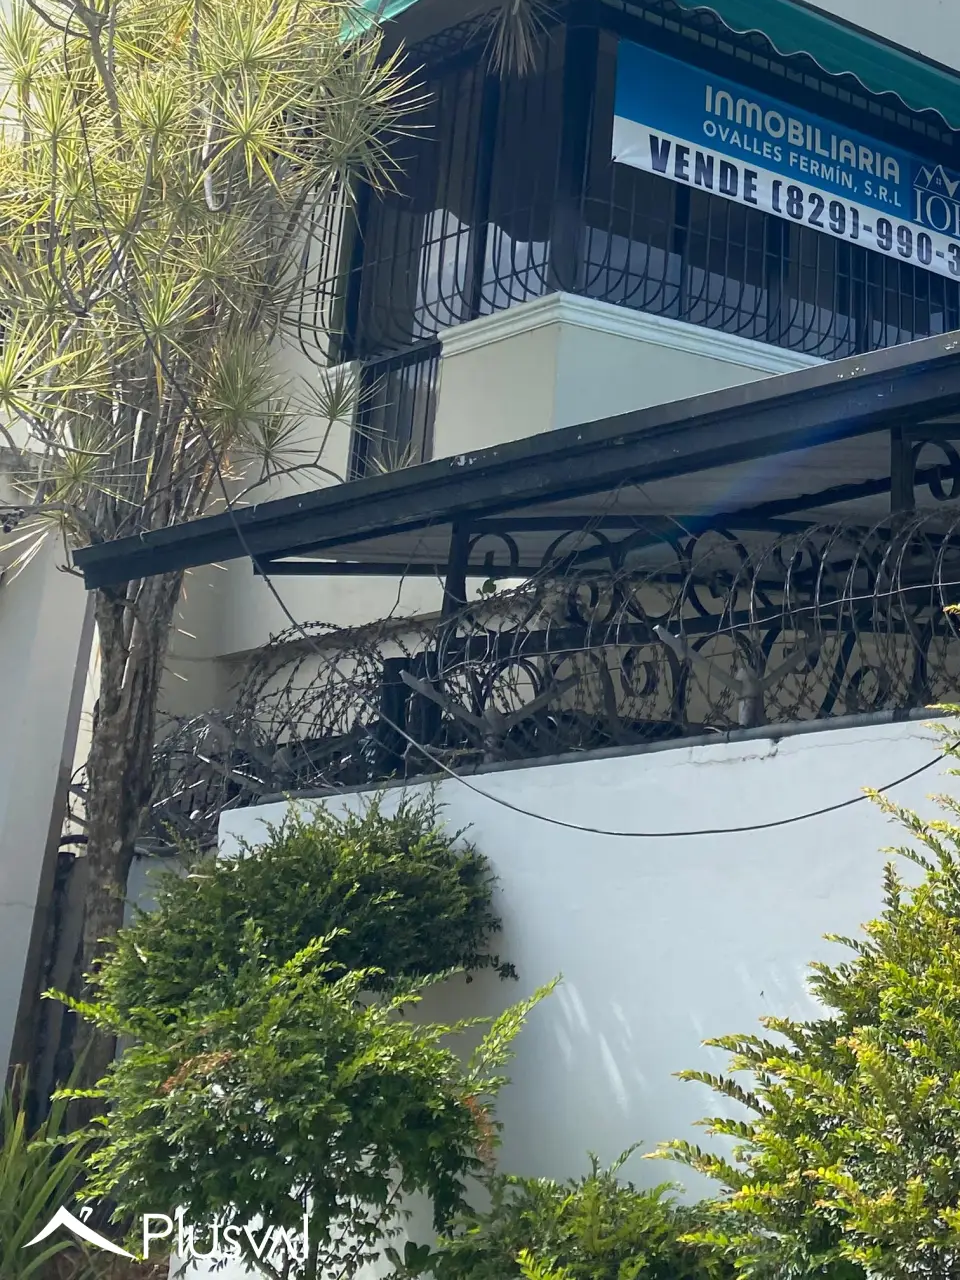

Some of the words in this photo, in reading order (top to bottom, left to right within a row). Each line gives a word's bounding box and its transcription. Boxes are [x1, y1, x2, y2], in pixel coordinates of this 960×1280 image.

[649, 133, 758, 205] VENDE
[703, 120, 783, 163] OVALLES
[789, 151, 858, 193] FERMÍN,
[864, 180, 902, 208] S.R.L
